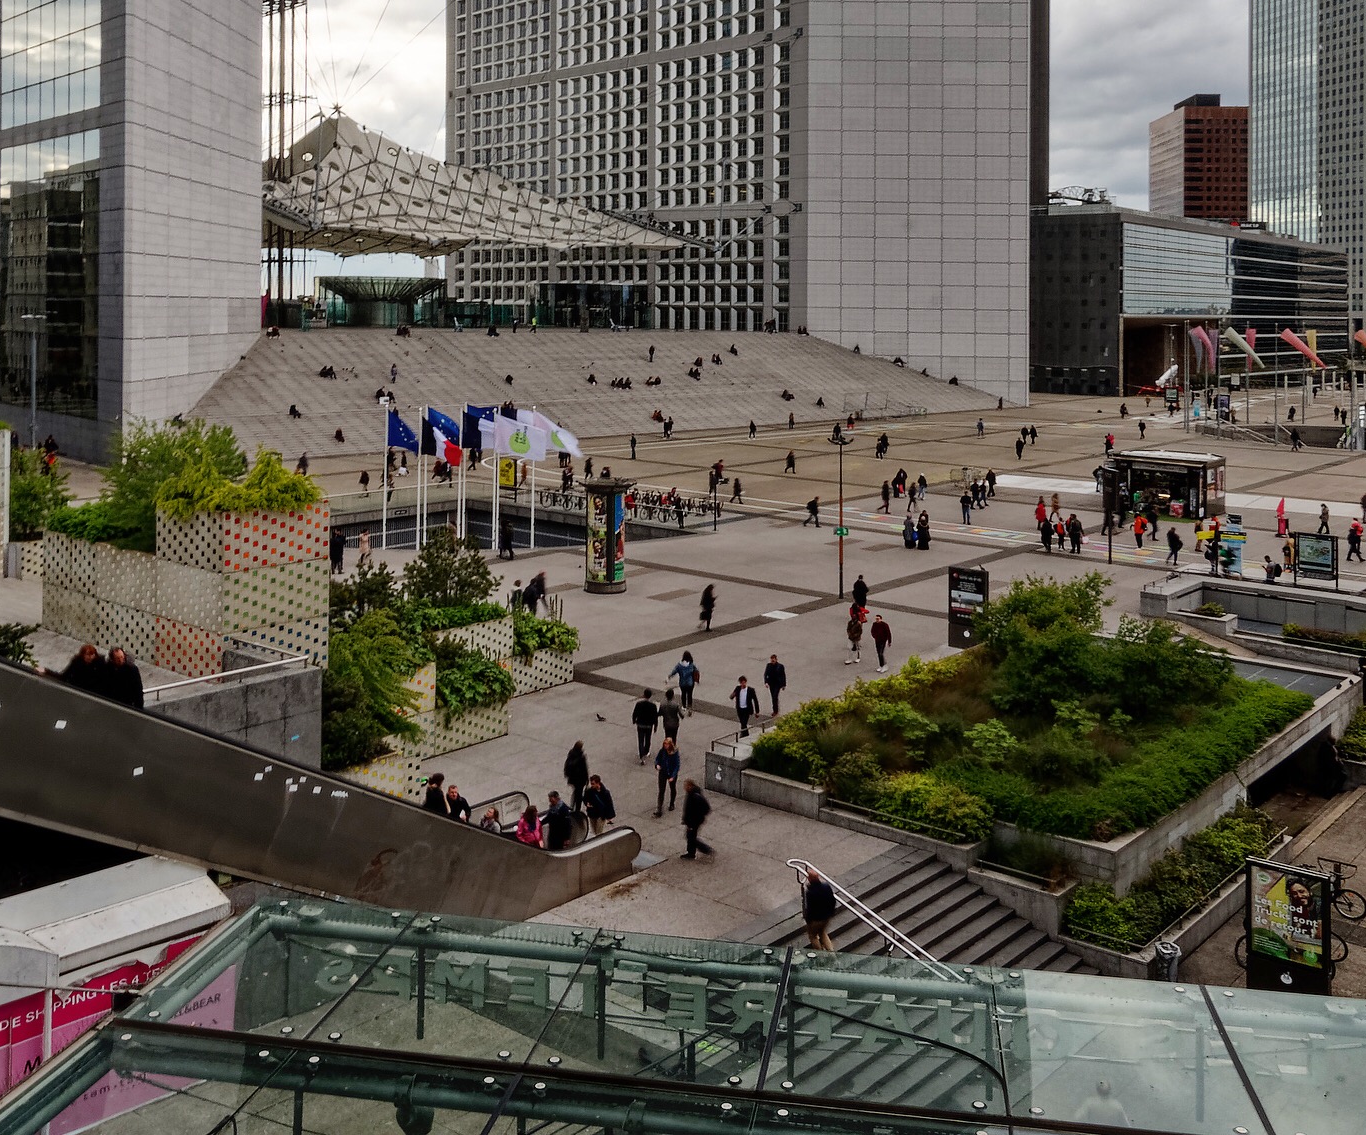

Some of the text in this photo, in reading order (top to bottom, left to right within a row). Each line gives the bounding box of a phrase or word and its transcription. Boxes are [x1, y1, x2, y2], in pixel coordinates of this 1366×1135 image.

[1254, 904, 1319, 928] Trucks sont
[1275, 899, 1303, 914] Food
[1254, 915, 1268, 926] de
[1270, 921, 1308, 935] retour
[0, 1016, 21, 1032] DE
[26, 989, 98, 1023] SHPPING
